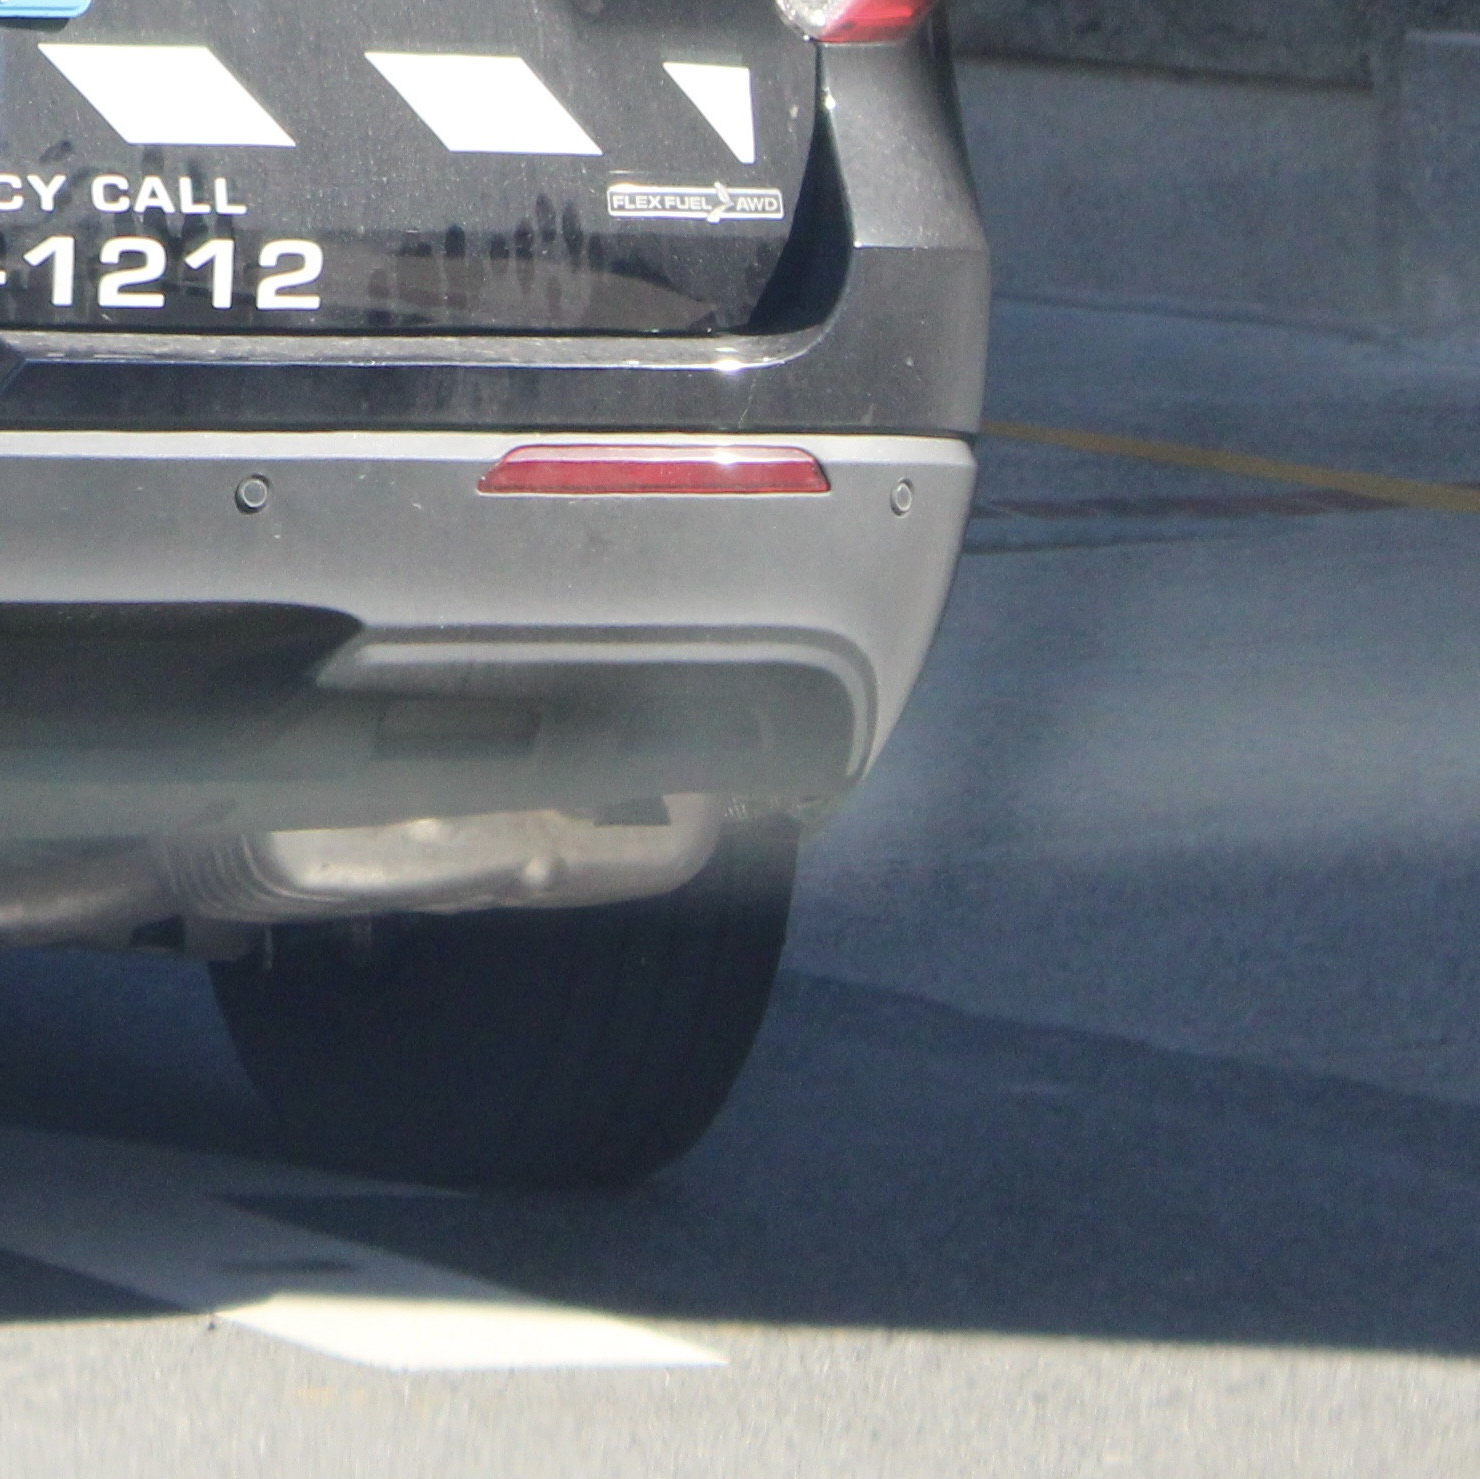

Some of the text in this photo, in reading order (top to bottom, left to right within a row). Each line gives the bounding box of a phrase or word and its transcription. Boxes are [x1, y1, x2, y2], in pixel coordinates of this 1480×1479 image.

[90, 174, 248, 215] CALL
[612, 194, 779, 212] FLEX FUEL AWD
